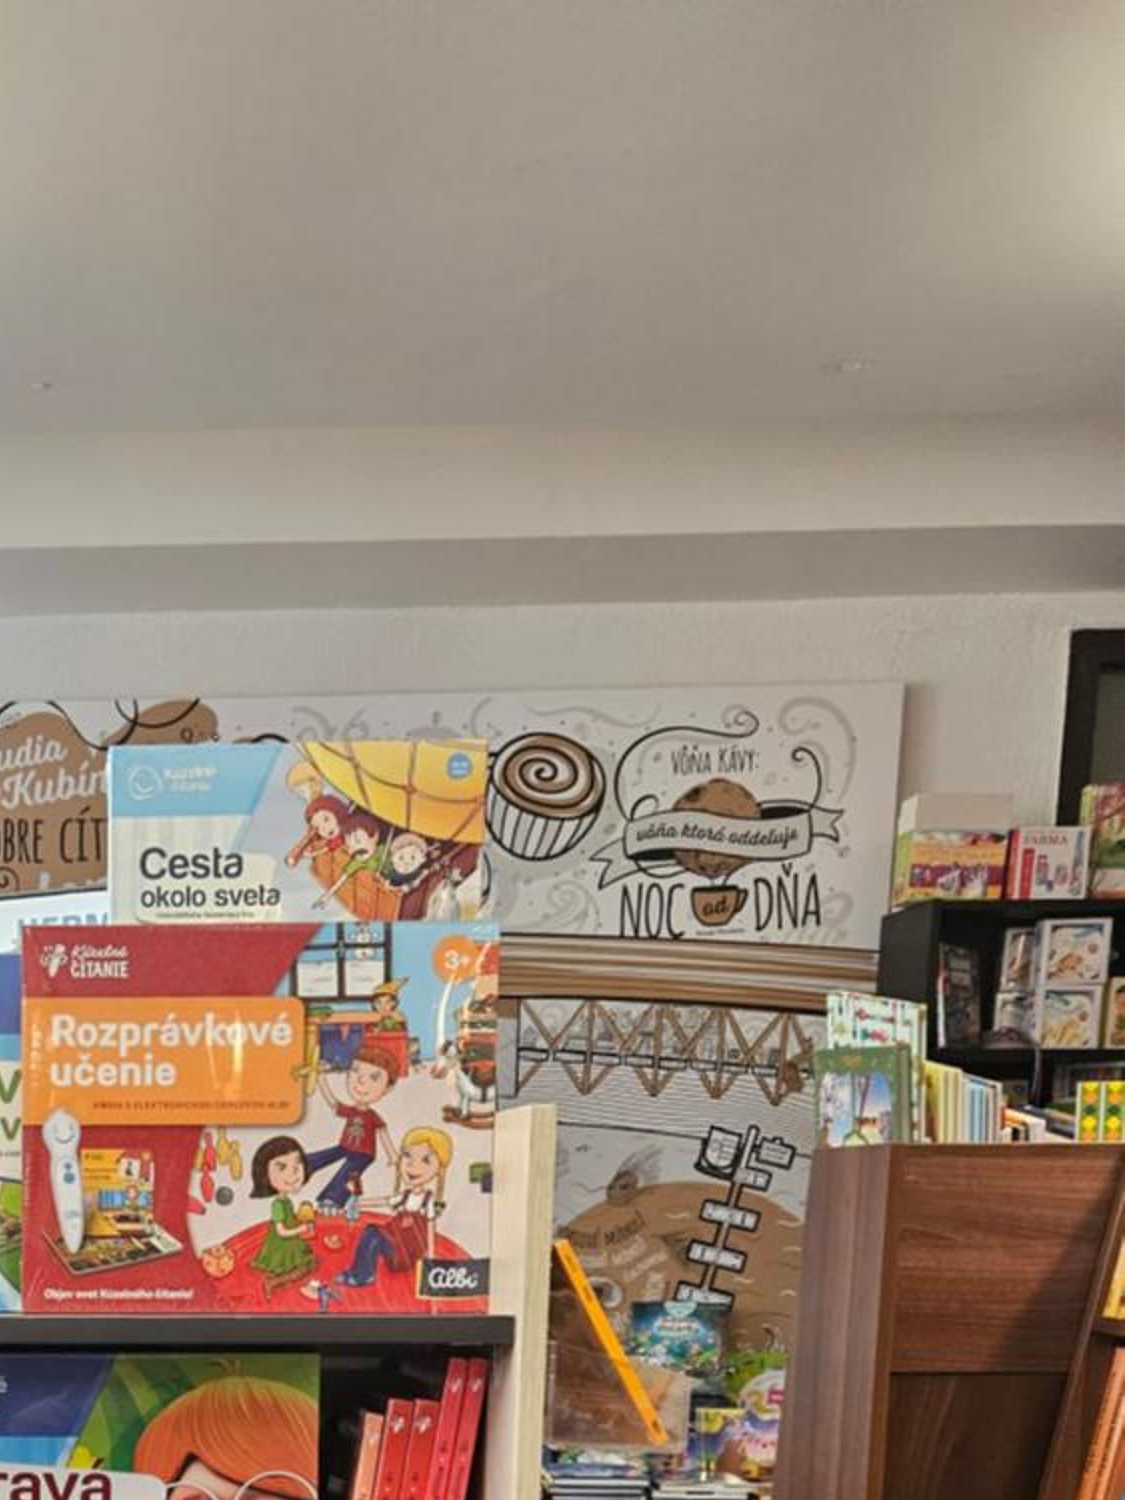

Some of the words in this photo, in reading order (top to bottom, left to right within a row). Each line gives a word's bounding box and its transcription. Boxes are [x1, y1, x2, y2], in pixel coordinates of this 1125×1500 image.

[681, 820, 725, 842] ktorá
[139, 847, 244, 880] Cesta
[140, 885, 207, 908] okolo
[214, 884, 281, 907] sveta
[619, 882, 687, 939] NOC
[753, 862, 821, 932] DŇA
[51, 1012, 293, 1056] Rozprávkové
[50, 1054, 177, 1087] učenie
